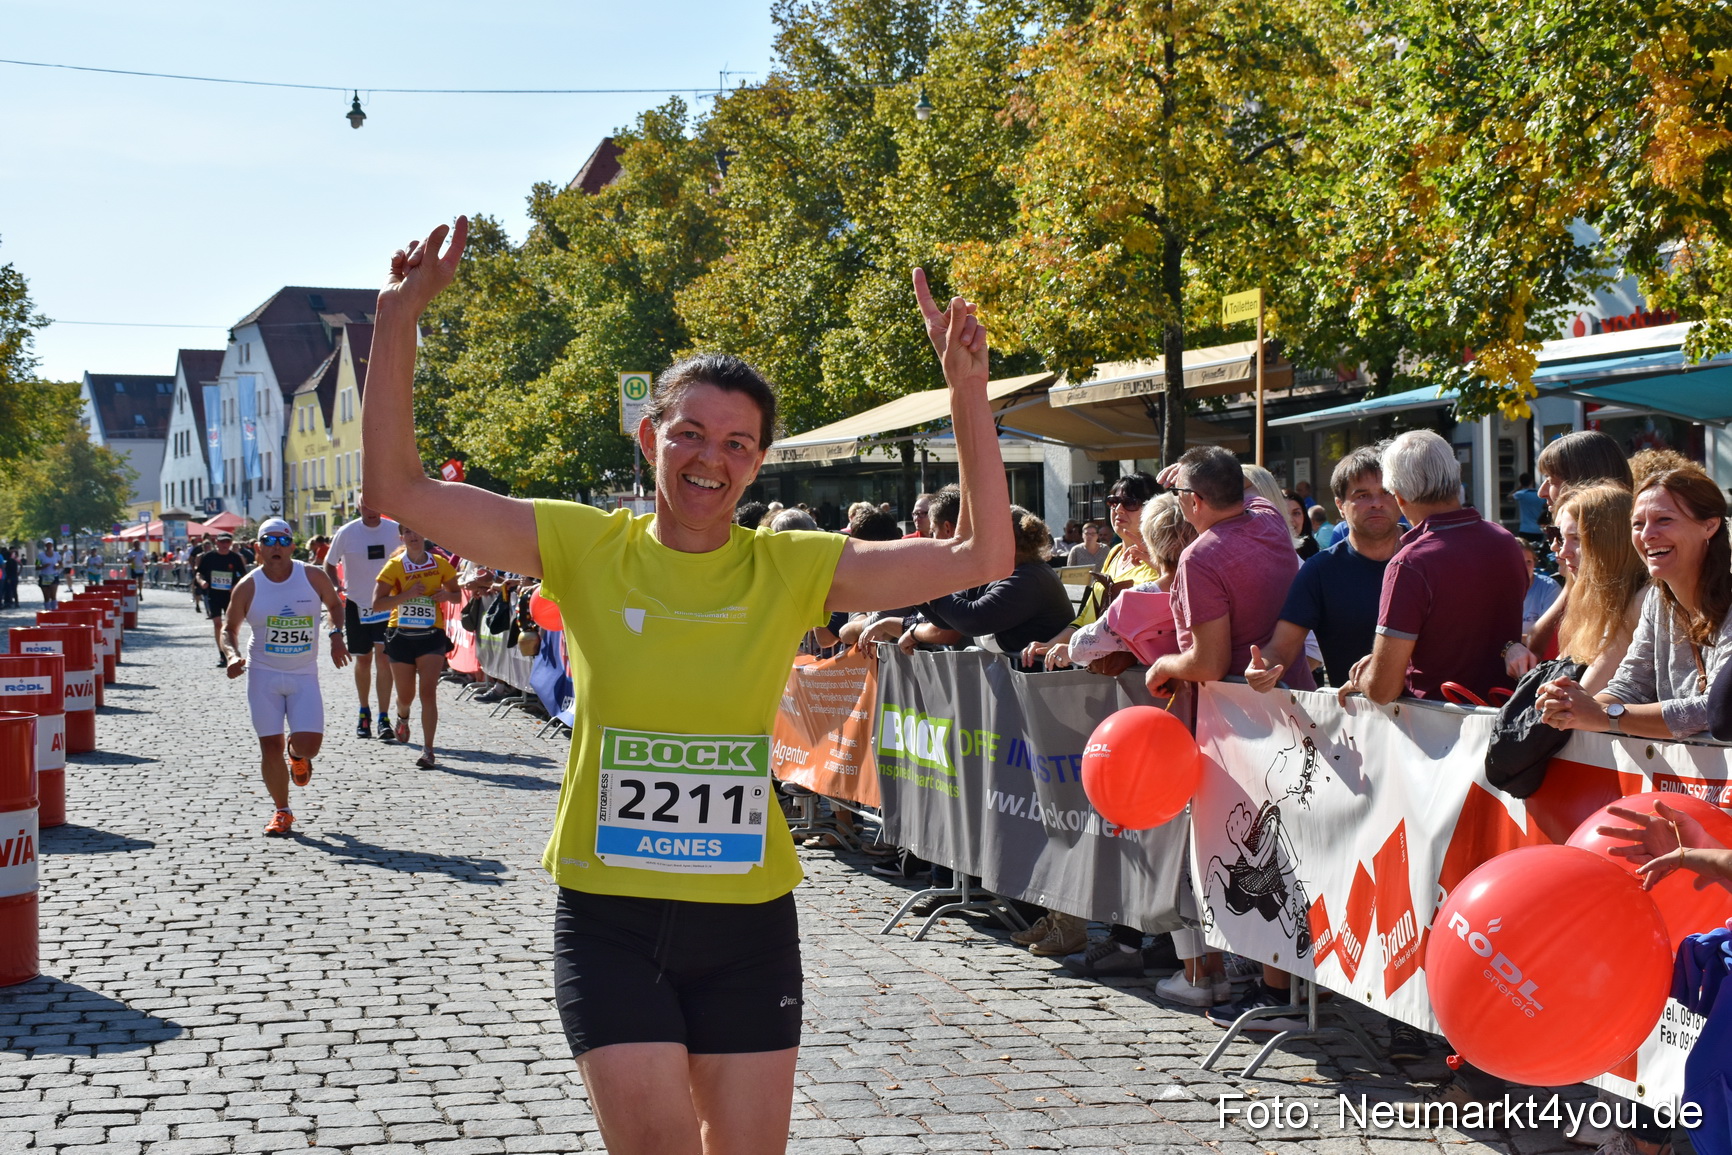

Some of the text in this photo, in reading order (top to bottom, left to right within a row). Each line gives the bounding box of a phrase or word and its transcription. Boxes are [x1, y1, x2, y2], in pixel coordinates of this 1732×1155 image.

[1229, 299, 1258, 315] Toiletten
[402, 605, 431, 617] 2385
[270, 630, 309, 643] 2354
[614, 735, 757, 772] BOCK
[772, 739, 809, 766] Agentur
[618, 779, 745, 825] 2211
[636, 836, 723, 857] AGNES
[1378, 909, 1415, 969] Braun
[1483, 969, 1535, 1018] energie
[1660, 1024, 1678, 1047] Fax
